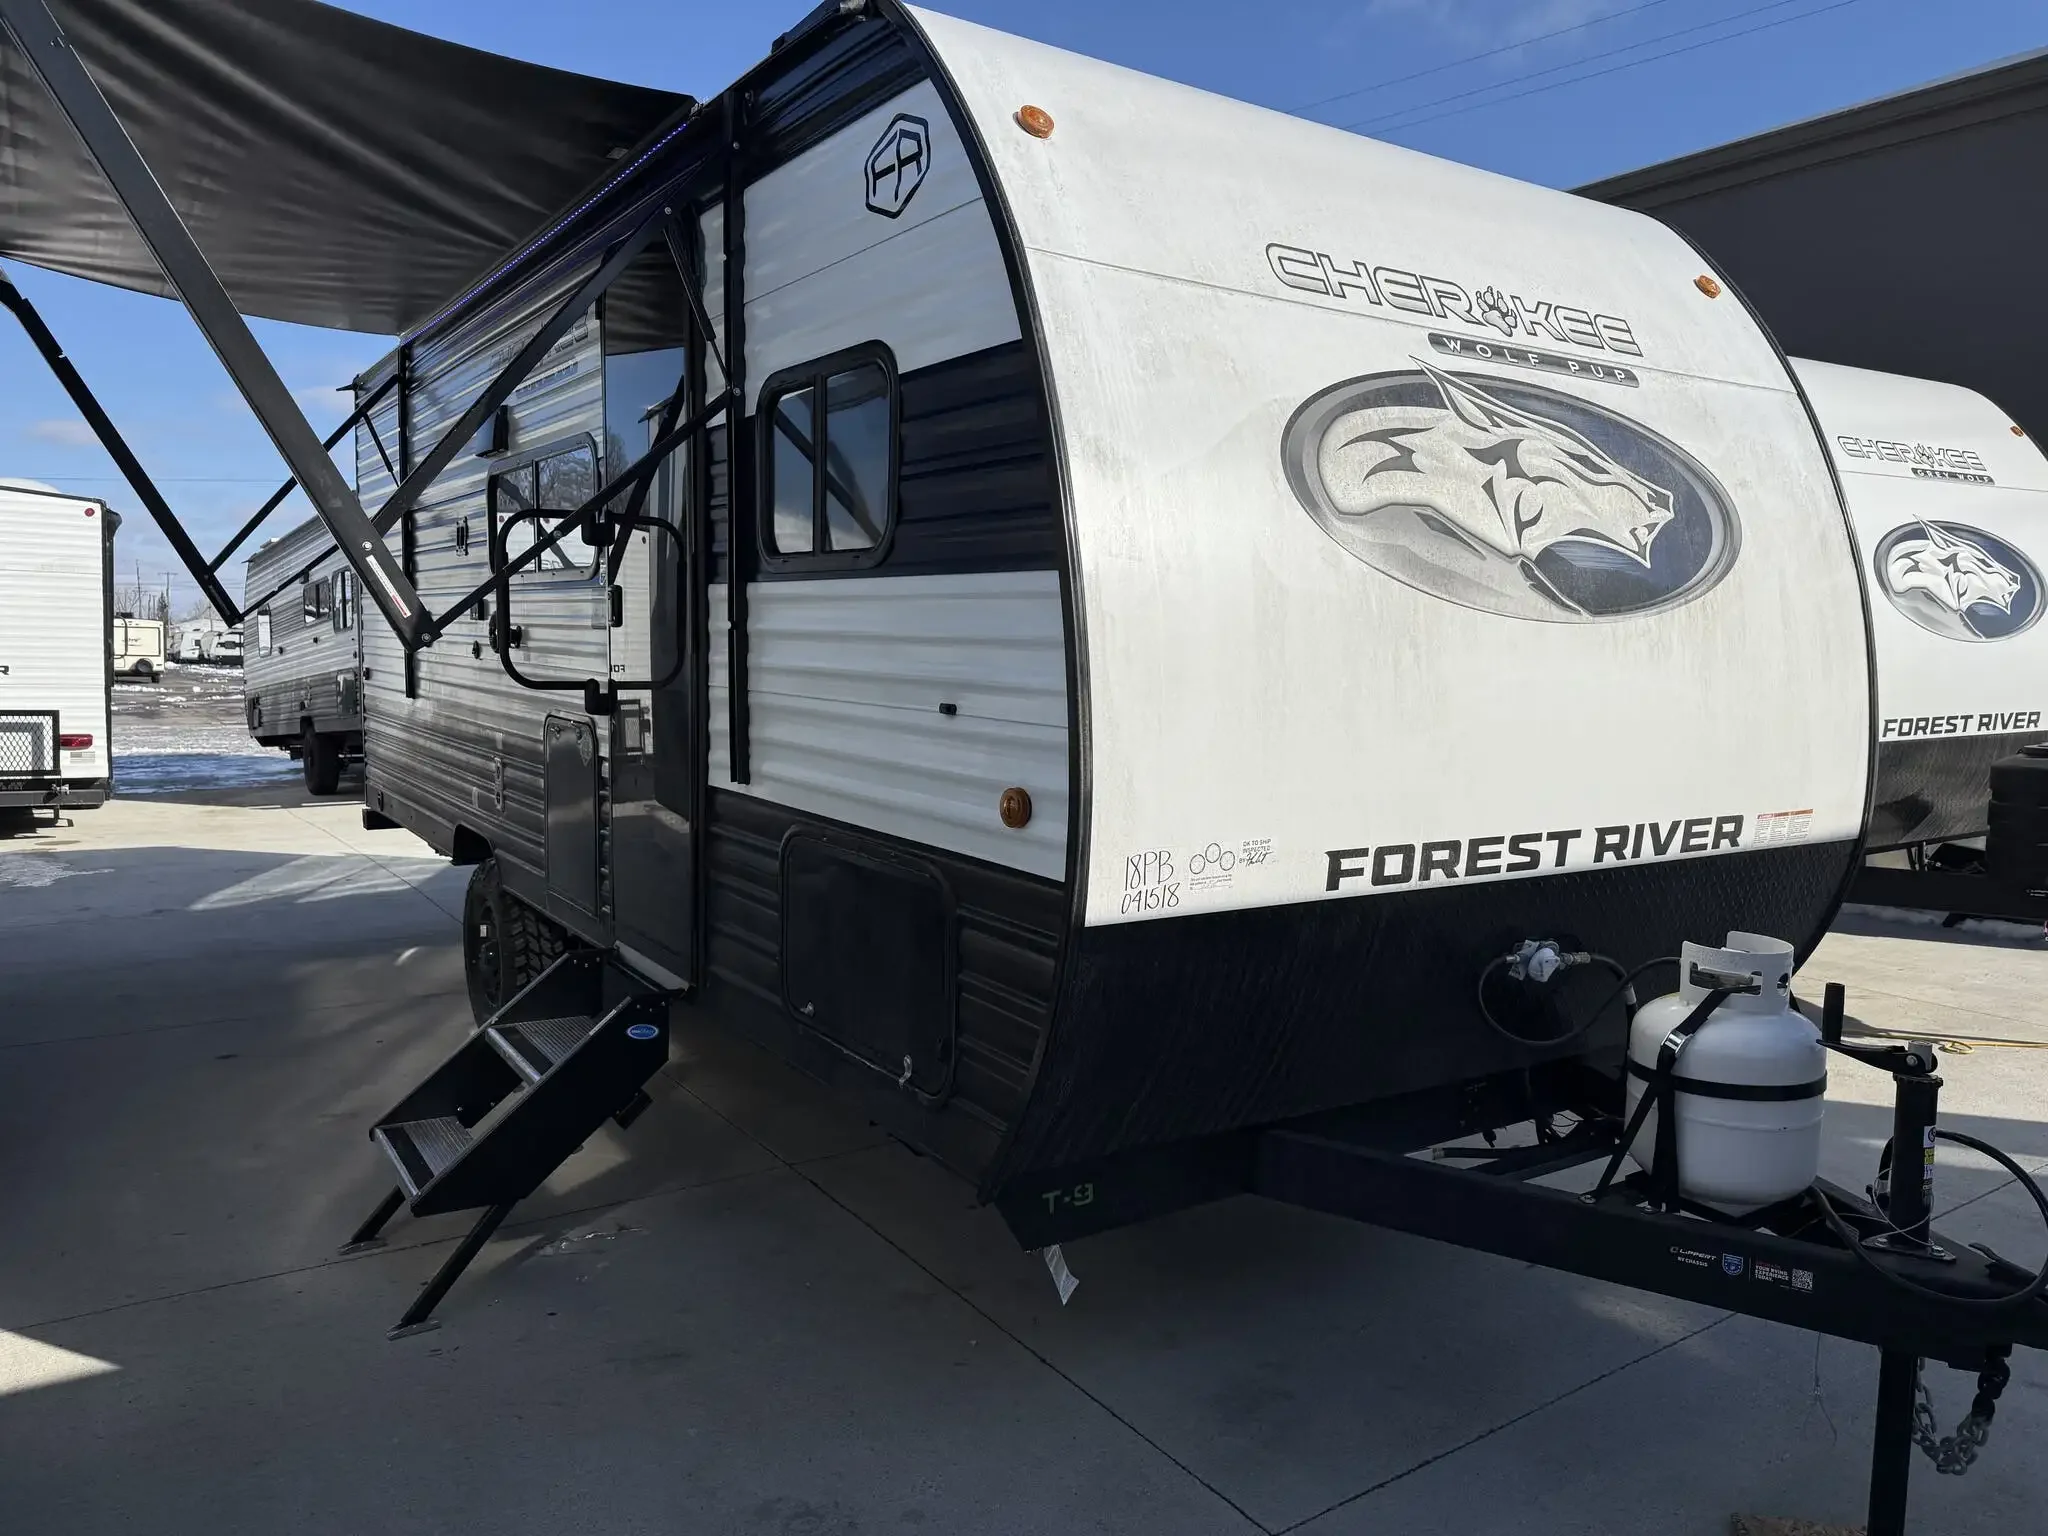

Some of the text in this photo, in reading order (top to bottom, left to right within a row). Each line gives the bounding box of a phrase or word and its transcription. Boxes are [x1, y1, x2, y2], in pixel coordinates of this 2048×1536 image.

[1442, 337, 1627, 383] WOLF PUP
[1917, 470, 1990, 484] GREY WOLF
[1882, 711, 2041, 738] FOREST RIVER
[1124, 850, 1175, 891] 18PB
[1324, 828, 1583, 892] FOREST
[1592, 814, 1745, 864] RIVER
